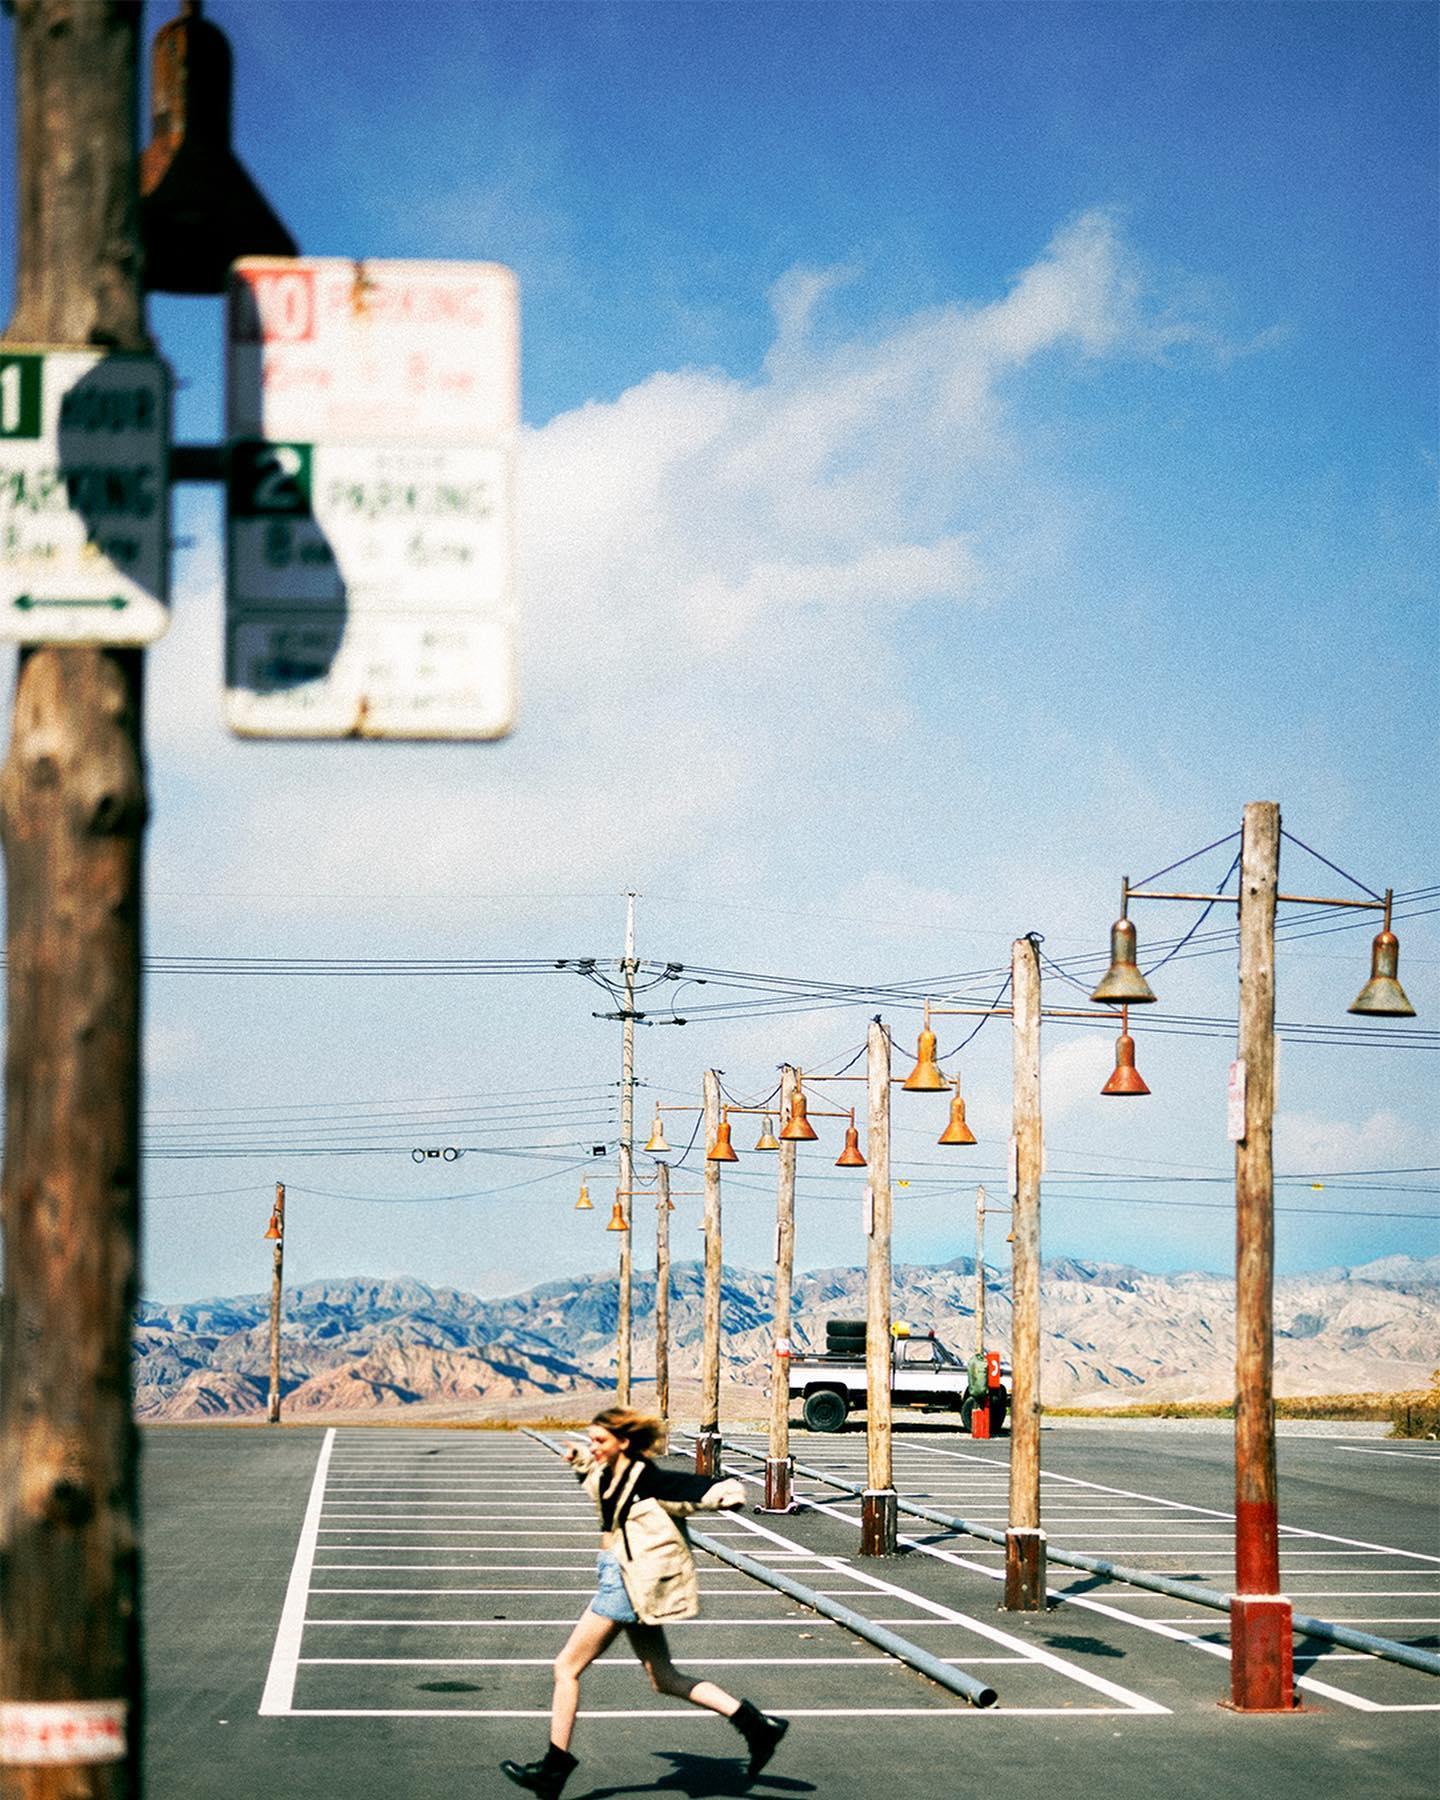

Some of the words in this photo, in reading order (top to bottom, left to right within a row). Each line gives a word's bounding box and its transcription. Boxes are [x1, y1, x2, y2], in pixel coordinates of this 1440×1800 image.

[0, 466, 154, 515] ARKING
[253, 447, 303, 506] 2
[327, 480, 495, 520] PARKING
